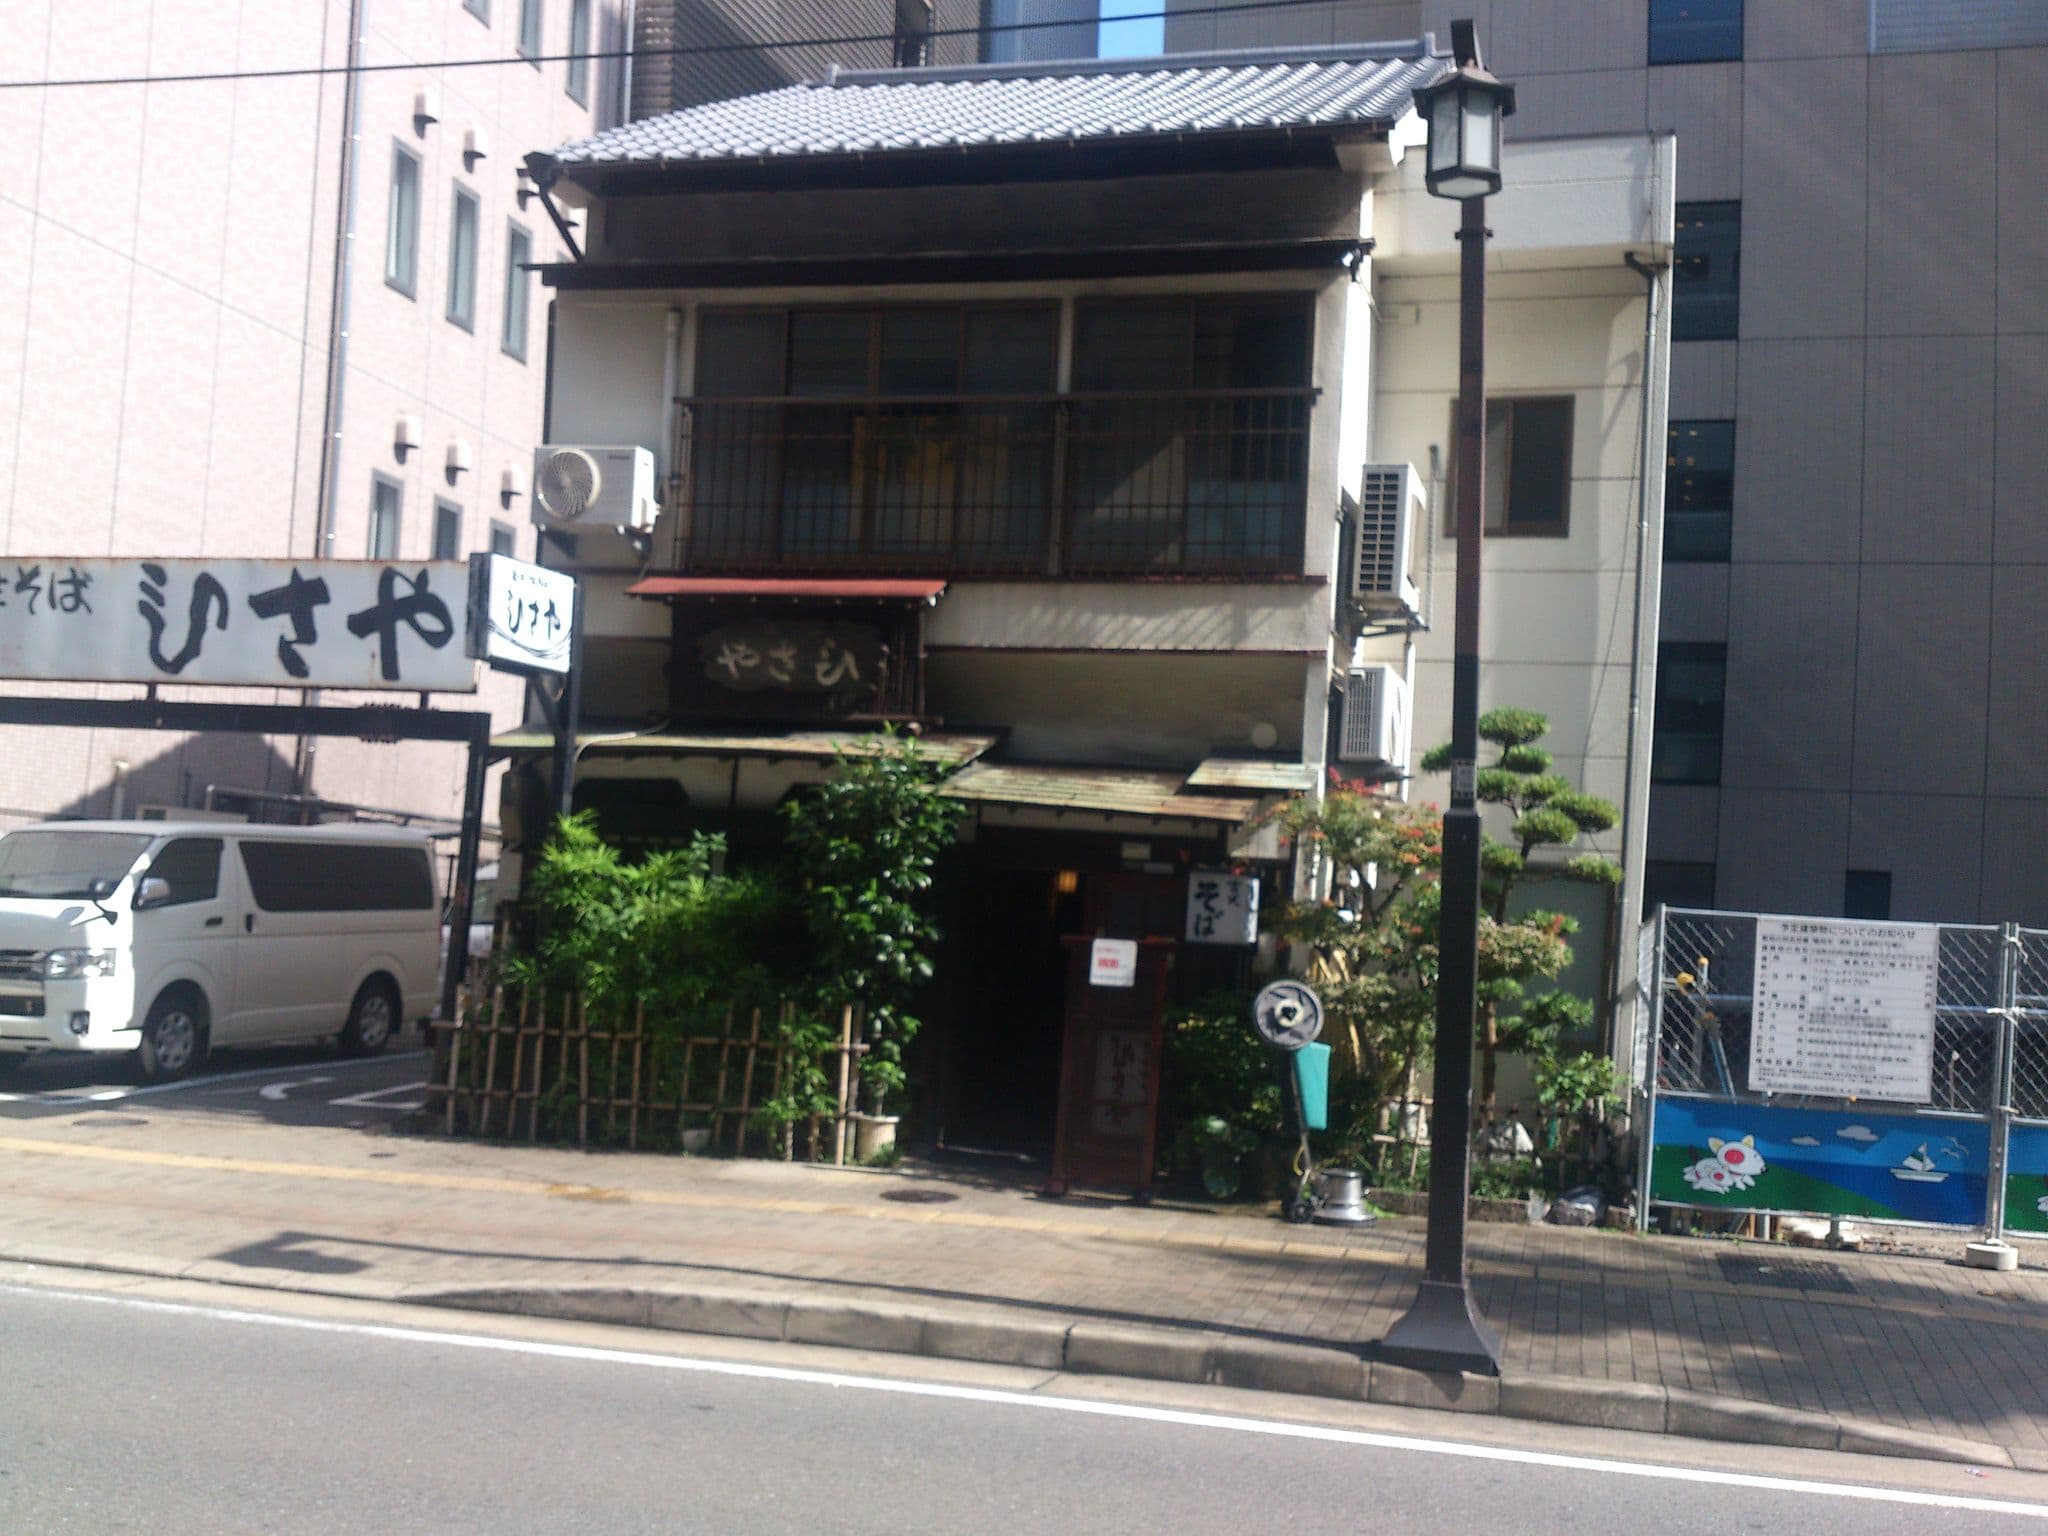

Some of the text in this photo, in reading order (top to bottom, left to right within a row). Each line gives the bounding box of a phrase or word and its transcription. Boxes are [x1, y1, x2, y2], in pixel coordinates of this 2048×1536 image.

[0, 563, 454, 680] そば ひさや
[507, 589, 561, 641] ひさや
